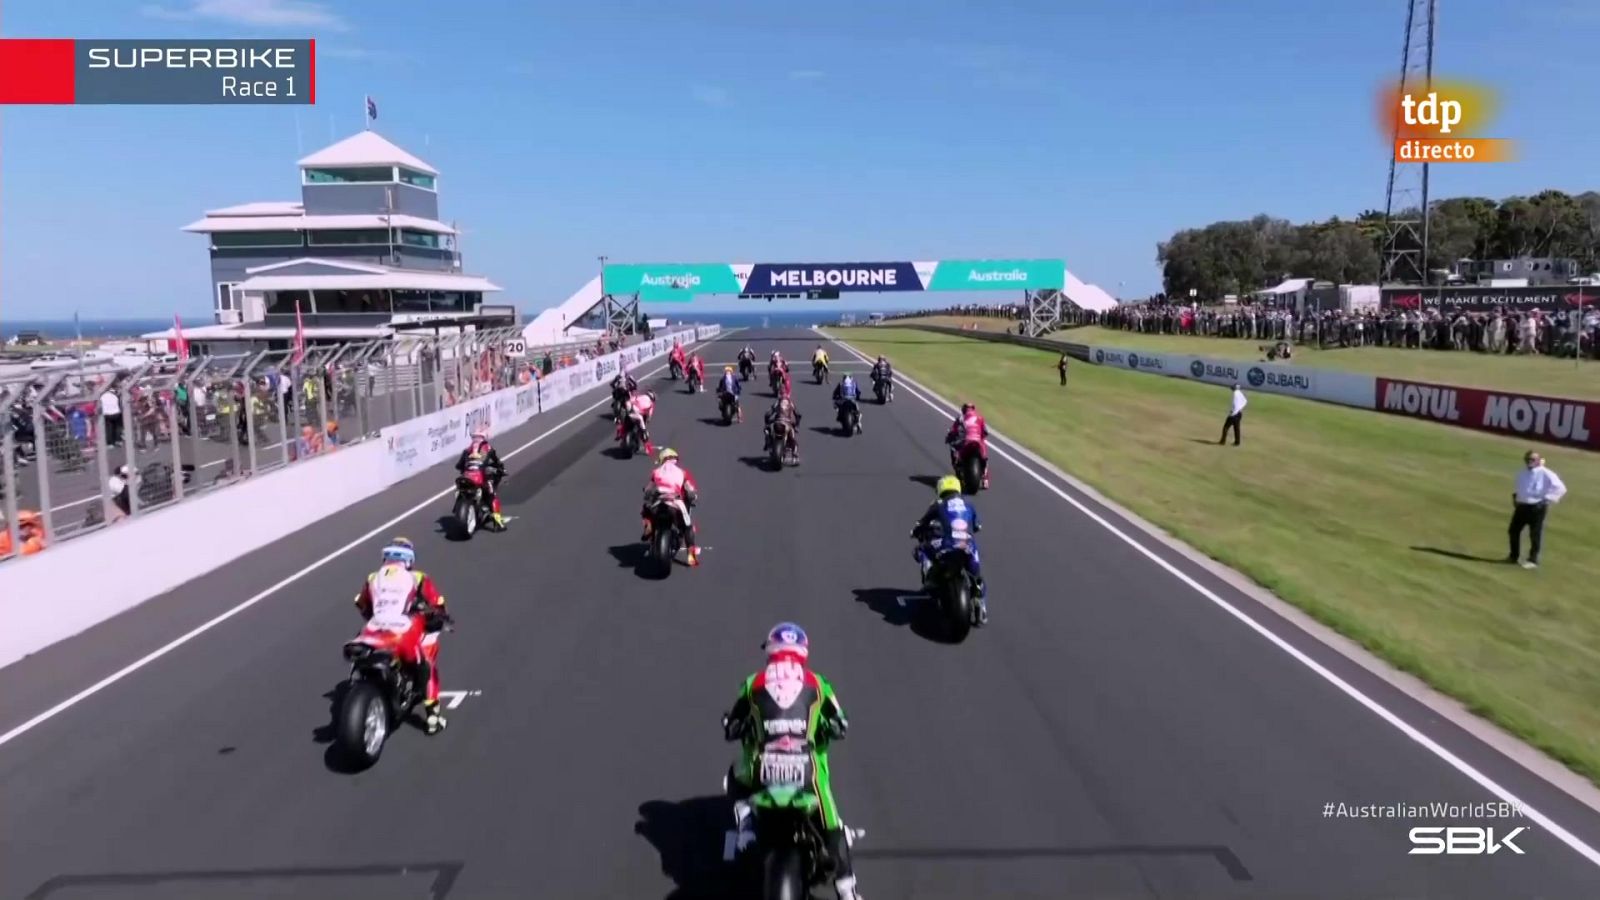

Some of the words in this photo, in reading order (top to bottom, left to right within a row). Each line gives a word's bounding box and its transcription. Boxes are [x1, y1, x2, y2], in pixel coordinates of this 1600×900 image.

[641, 272, 701, 288] Australia
[770, 269, 898, 287] MELBOURNE
[968, 269, 1028, 282] Australia
[1424, 296, 1441, 306] WE
[1445, 296, 1479, 305] MAKE
[1482, 295, 1557, 305] EXCITEMENT
[508, 342, 524, 353] 20
[1206, 364, 1238, 380] SUBARU
[1267, 372, 1309, 389] SUBARU
[1384, 381, 1460, 421] MOTUL
[1483, 394, 1590, 441] MOTUL
